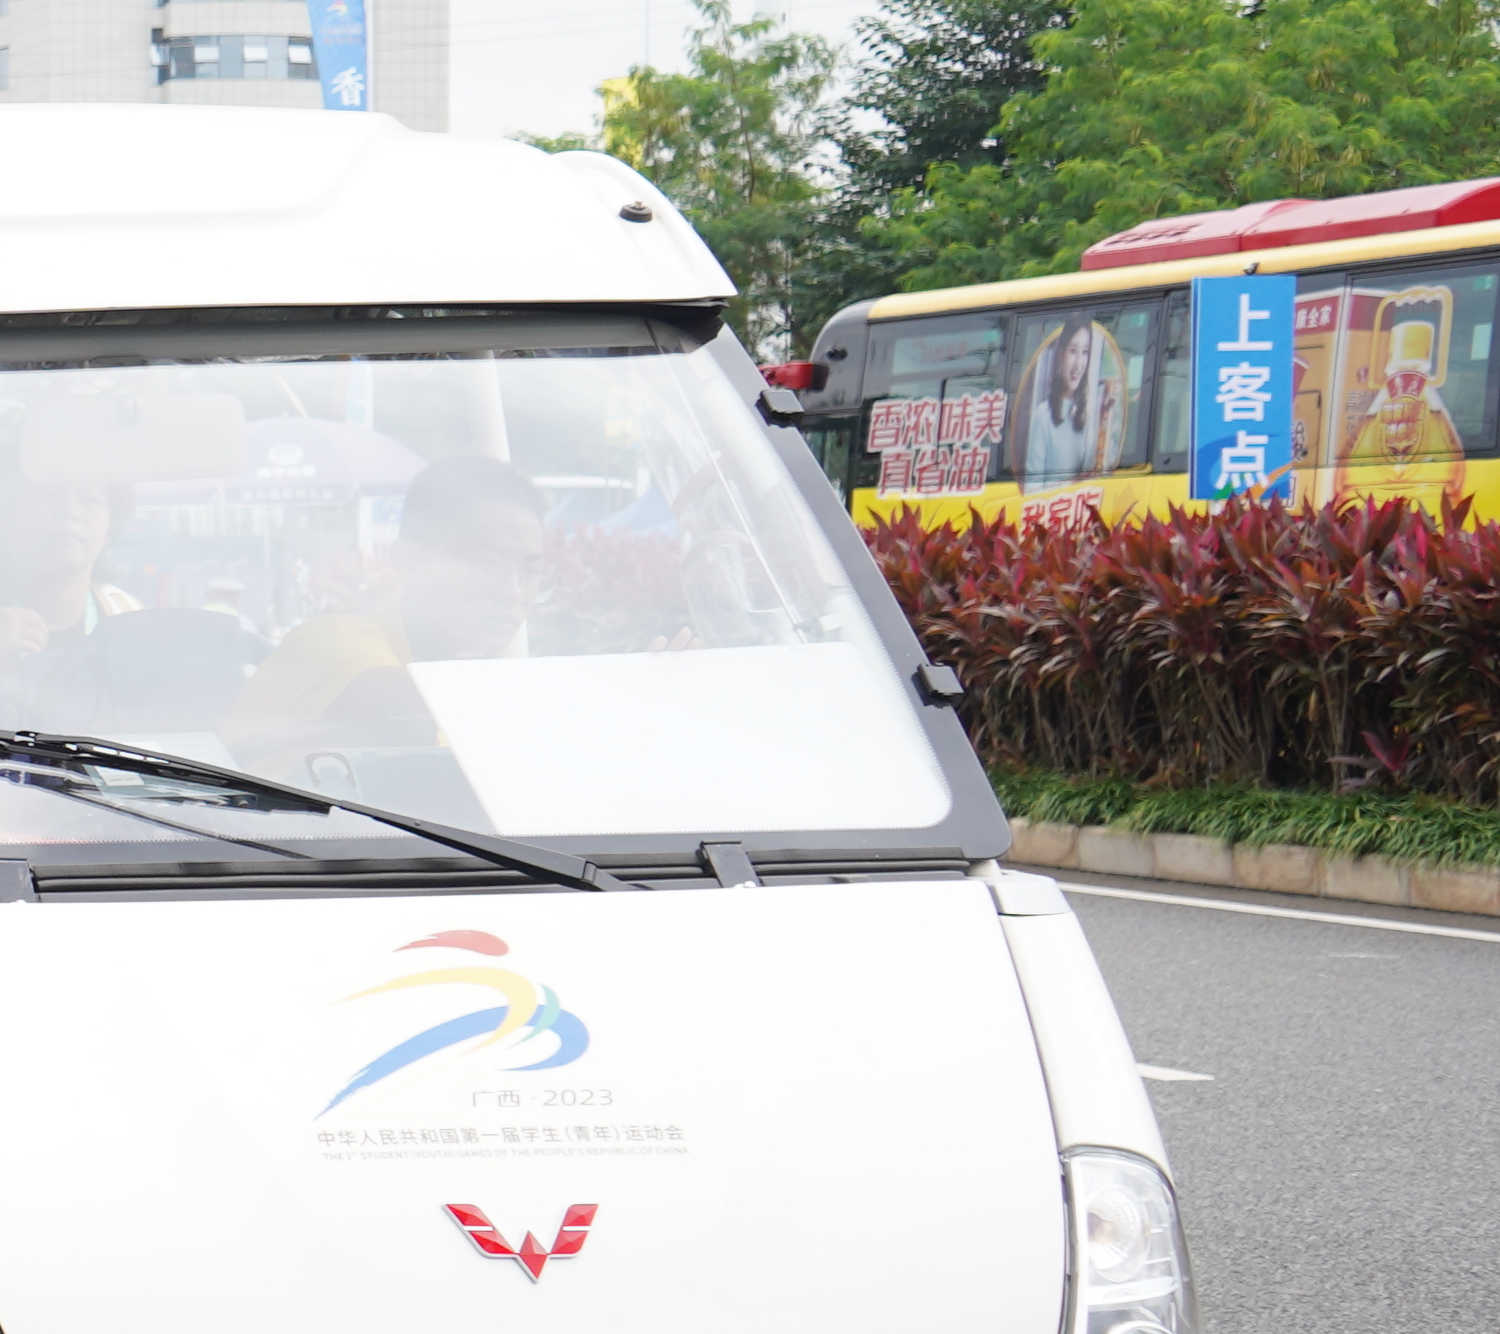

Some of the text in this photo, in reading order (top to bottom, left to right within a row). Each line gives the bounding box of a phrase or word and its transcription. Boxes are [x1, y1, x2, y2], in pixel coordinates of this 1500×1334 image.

[1214, 292, 1274, 489] 上客点
[867, 390, 1007, 451] 香浓味美
[878, 446, 990, 495] 真省油
[317, 1123, 686, 1148] 中华人民共和国第一届学生(青年)运动会
[322, 1152, 345, 1161] THE
[360, 1151, 409, 1161] STUDENT
[410, 1150, 455, 1160] (YOUTH)
[456, 1149, 494, 1159] GAMES
[495, 1149, 508, 1158] OF
[511, 1148, 531, 1157] THE
[533, 1147, 585, 1157] PEOPLE'S
[587, 1146, 638, 1156] REPUBLIC
[640, 1146, 654, 1155] OF
[656, 1146, 690, 1155] CHINA
